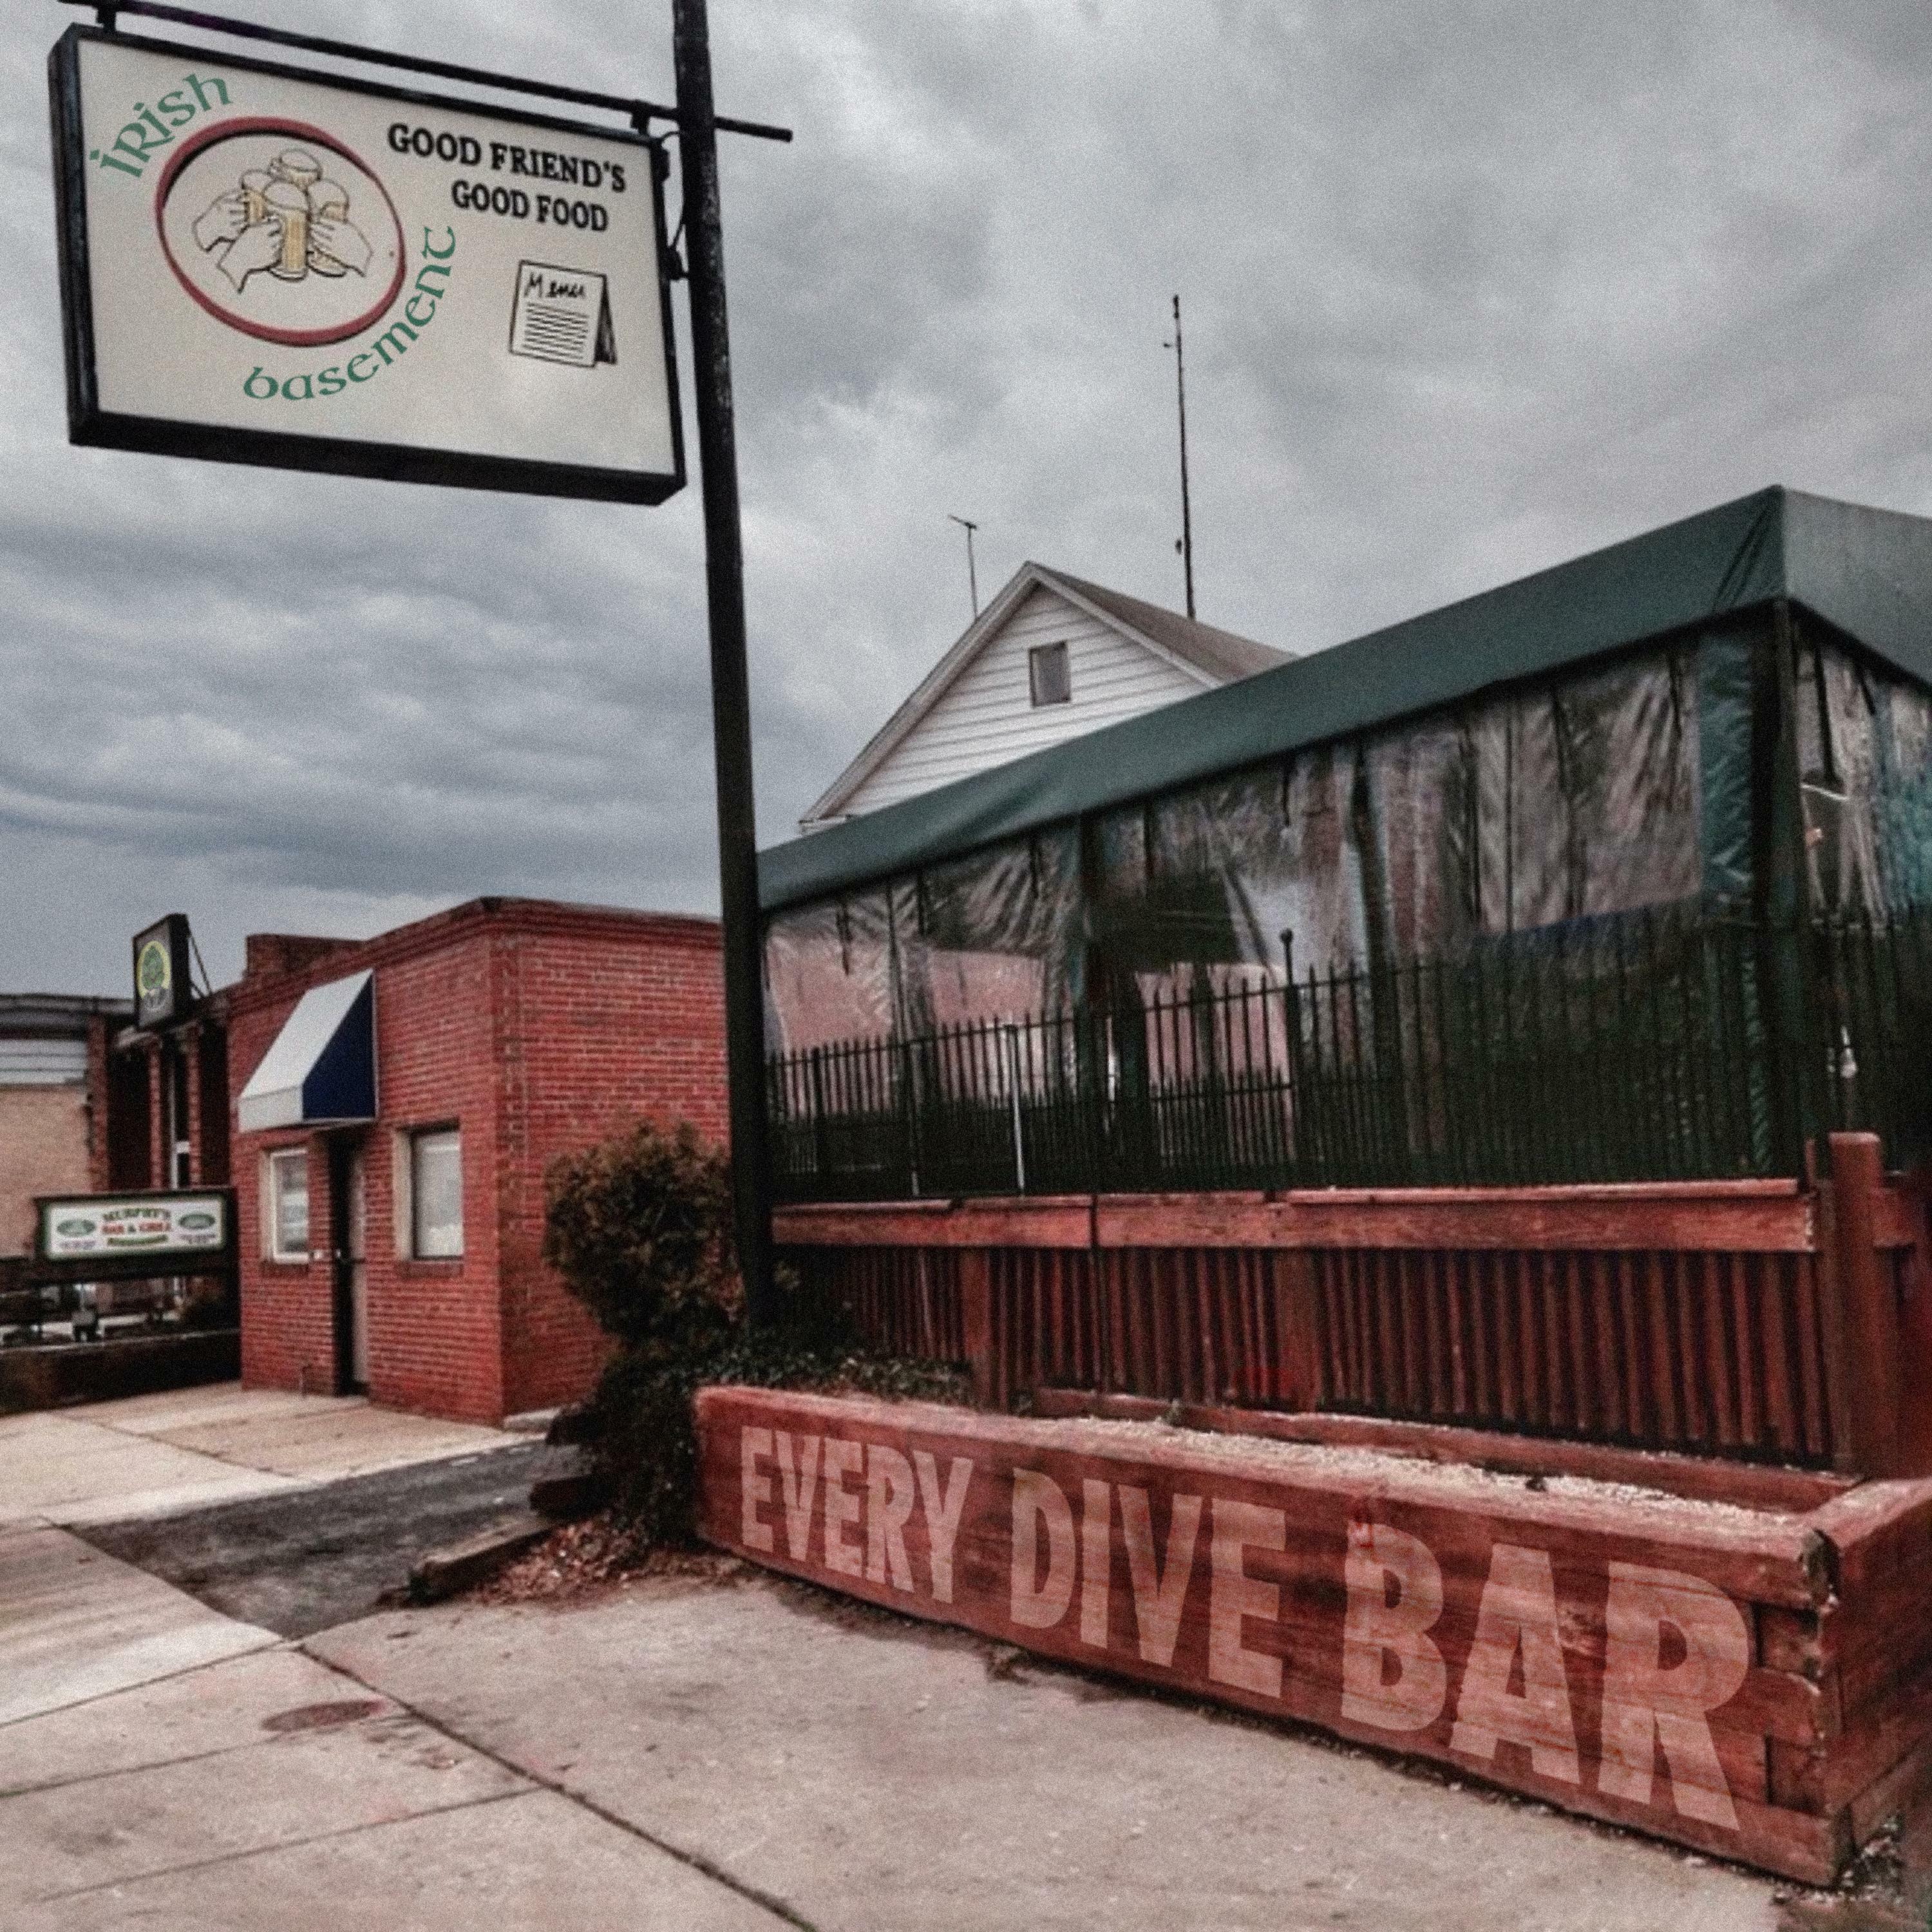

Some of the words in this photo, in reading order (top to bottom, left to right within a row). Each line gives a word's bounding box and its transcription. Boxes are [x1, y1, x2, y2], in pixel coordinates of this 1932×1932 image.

[388, 123, 482, 166] GOOD
[489, 141, 627, 193] FRIEND'S
[451, 179, 530, 220] GOOD
[536, 194, 609, 231] FOOD
[741, 1426, 974, 1604] EVERY
[1010, 1468, 1287, 1698] DIVE
[1341, 1520, 1750, 1831] BAR
